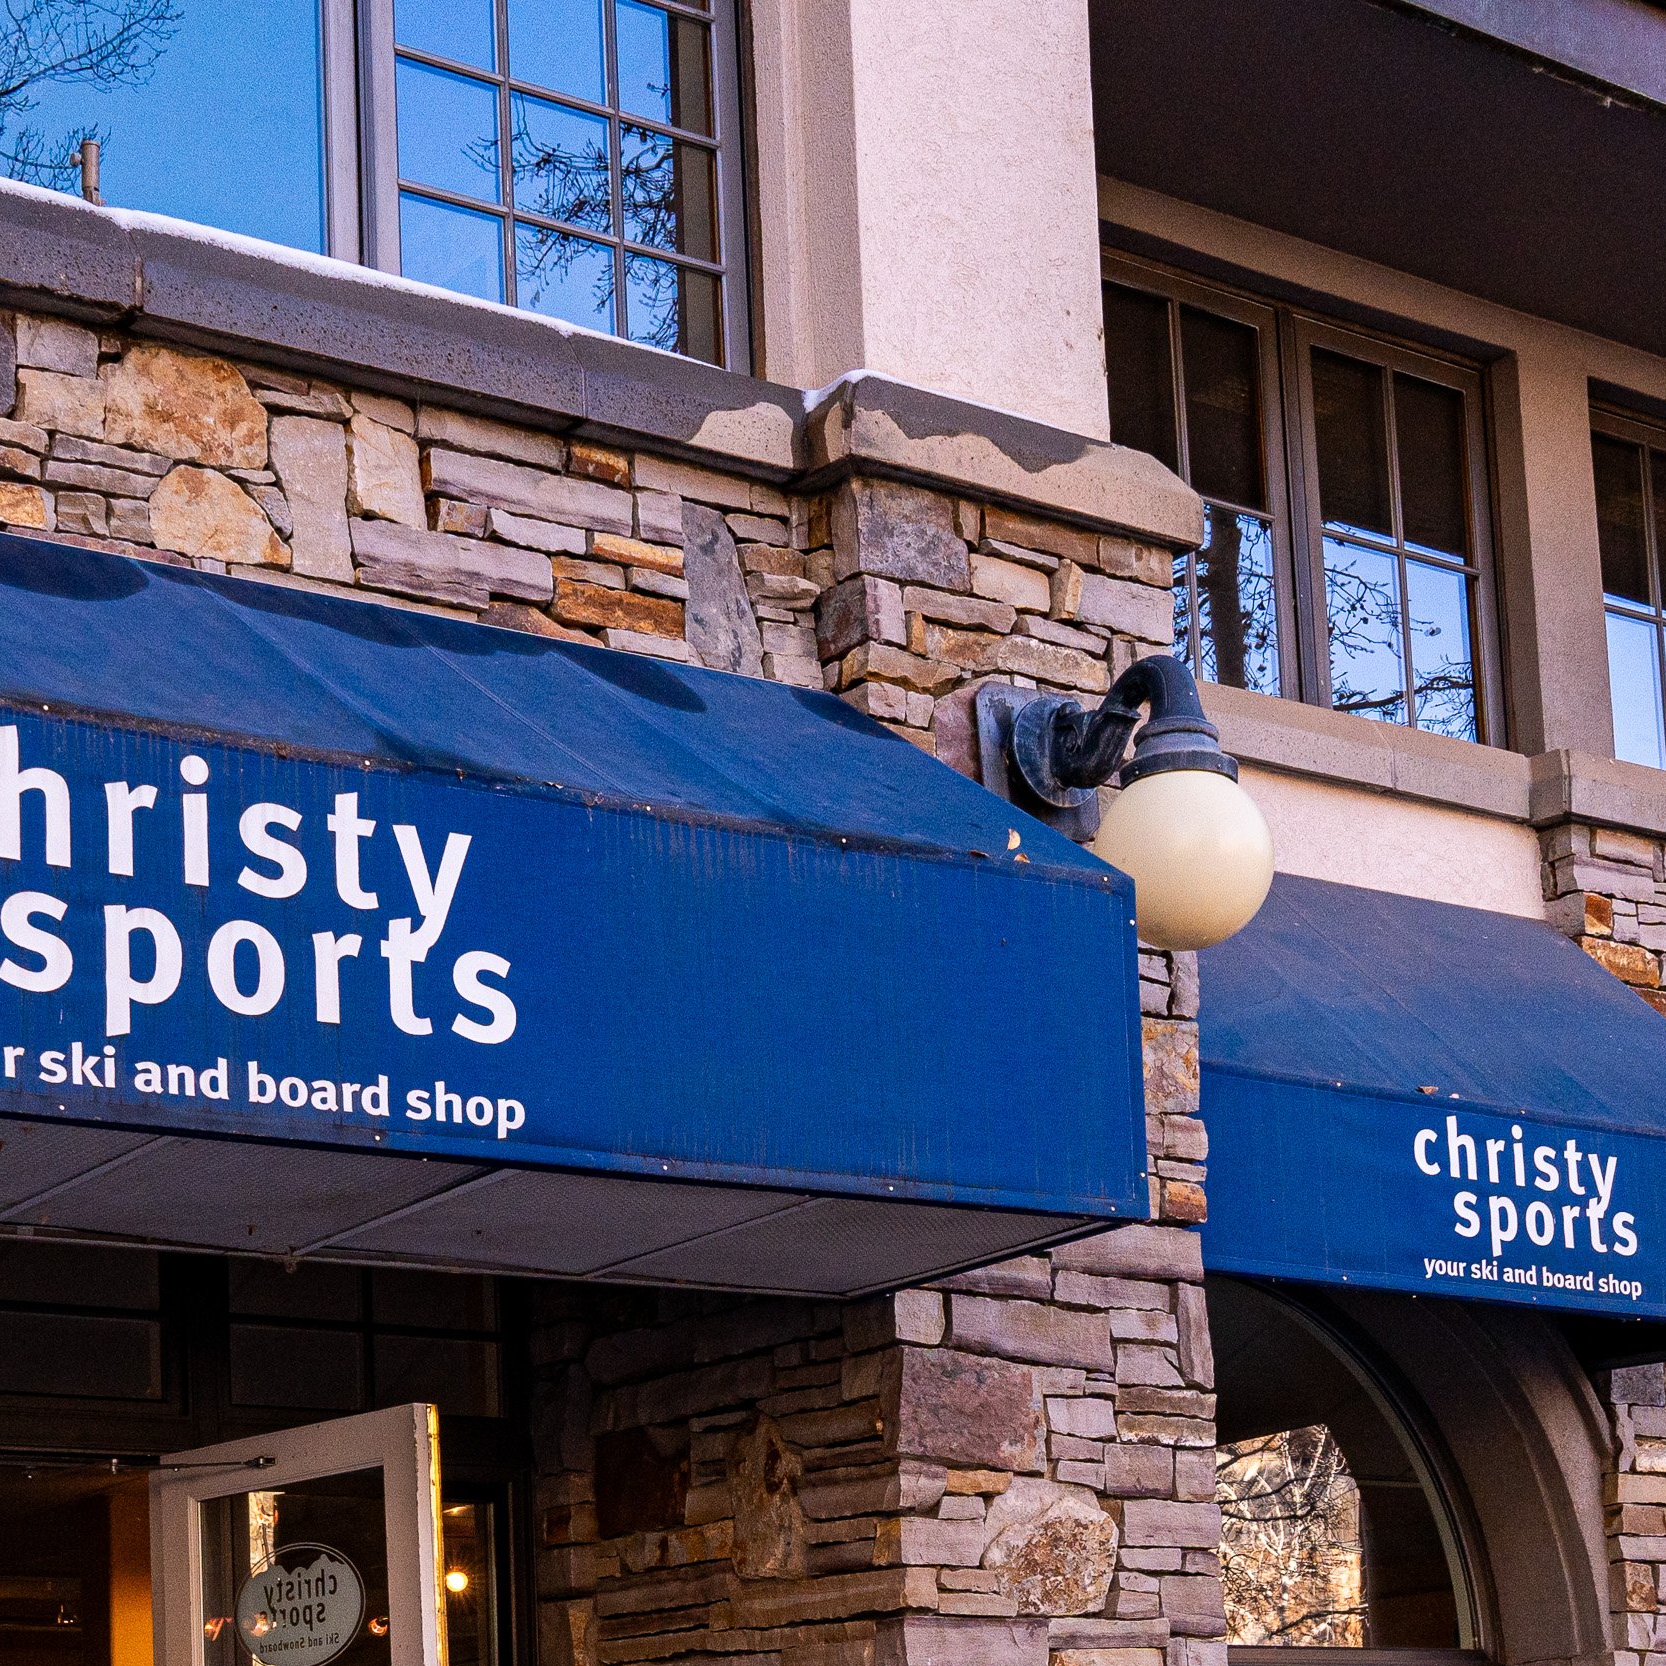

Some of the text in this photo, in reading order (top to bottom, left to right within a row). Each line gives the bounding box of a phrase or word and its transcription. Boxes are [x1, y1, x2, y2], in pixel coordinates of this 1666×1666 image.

[39, 1041, 117, 1089] ski
[134, 1057, 229, 1101] and
[248, 1060, 390, 1117] board
[405, 1080, 526, 1139] shop
[1413, 1115, 1618, 1214] christy
[1453, 1190, 1638, 1257] sports
[1423, 1257, 1643, 1300] your ski and board shop
